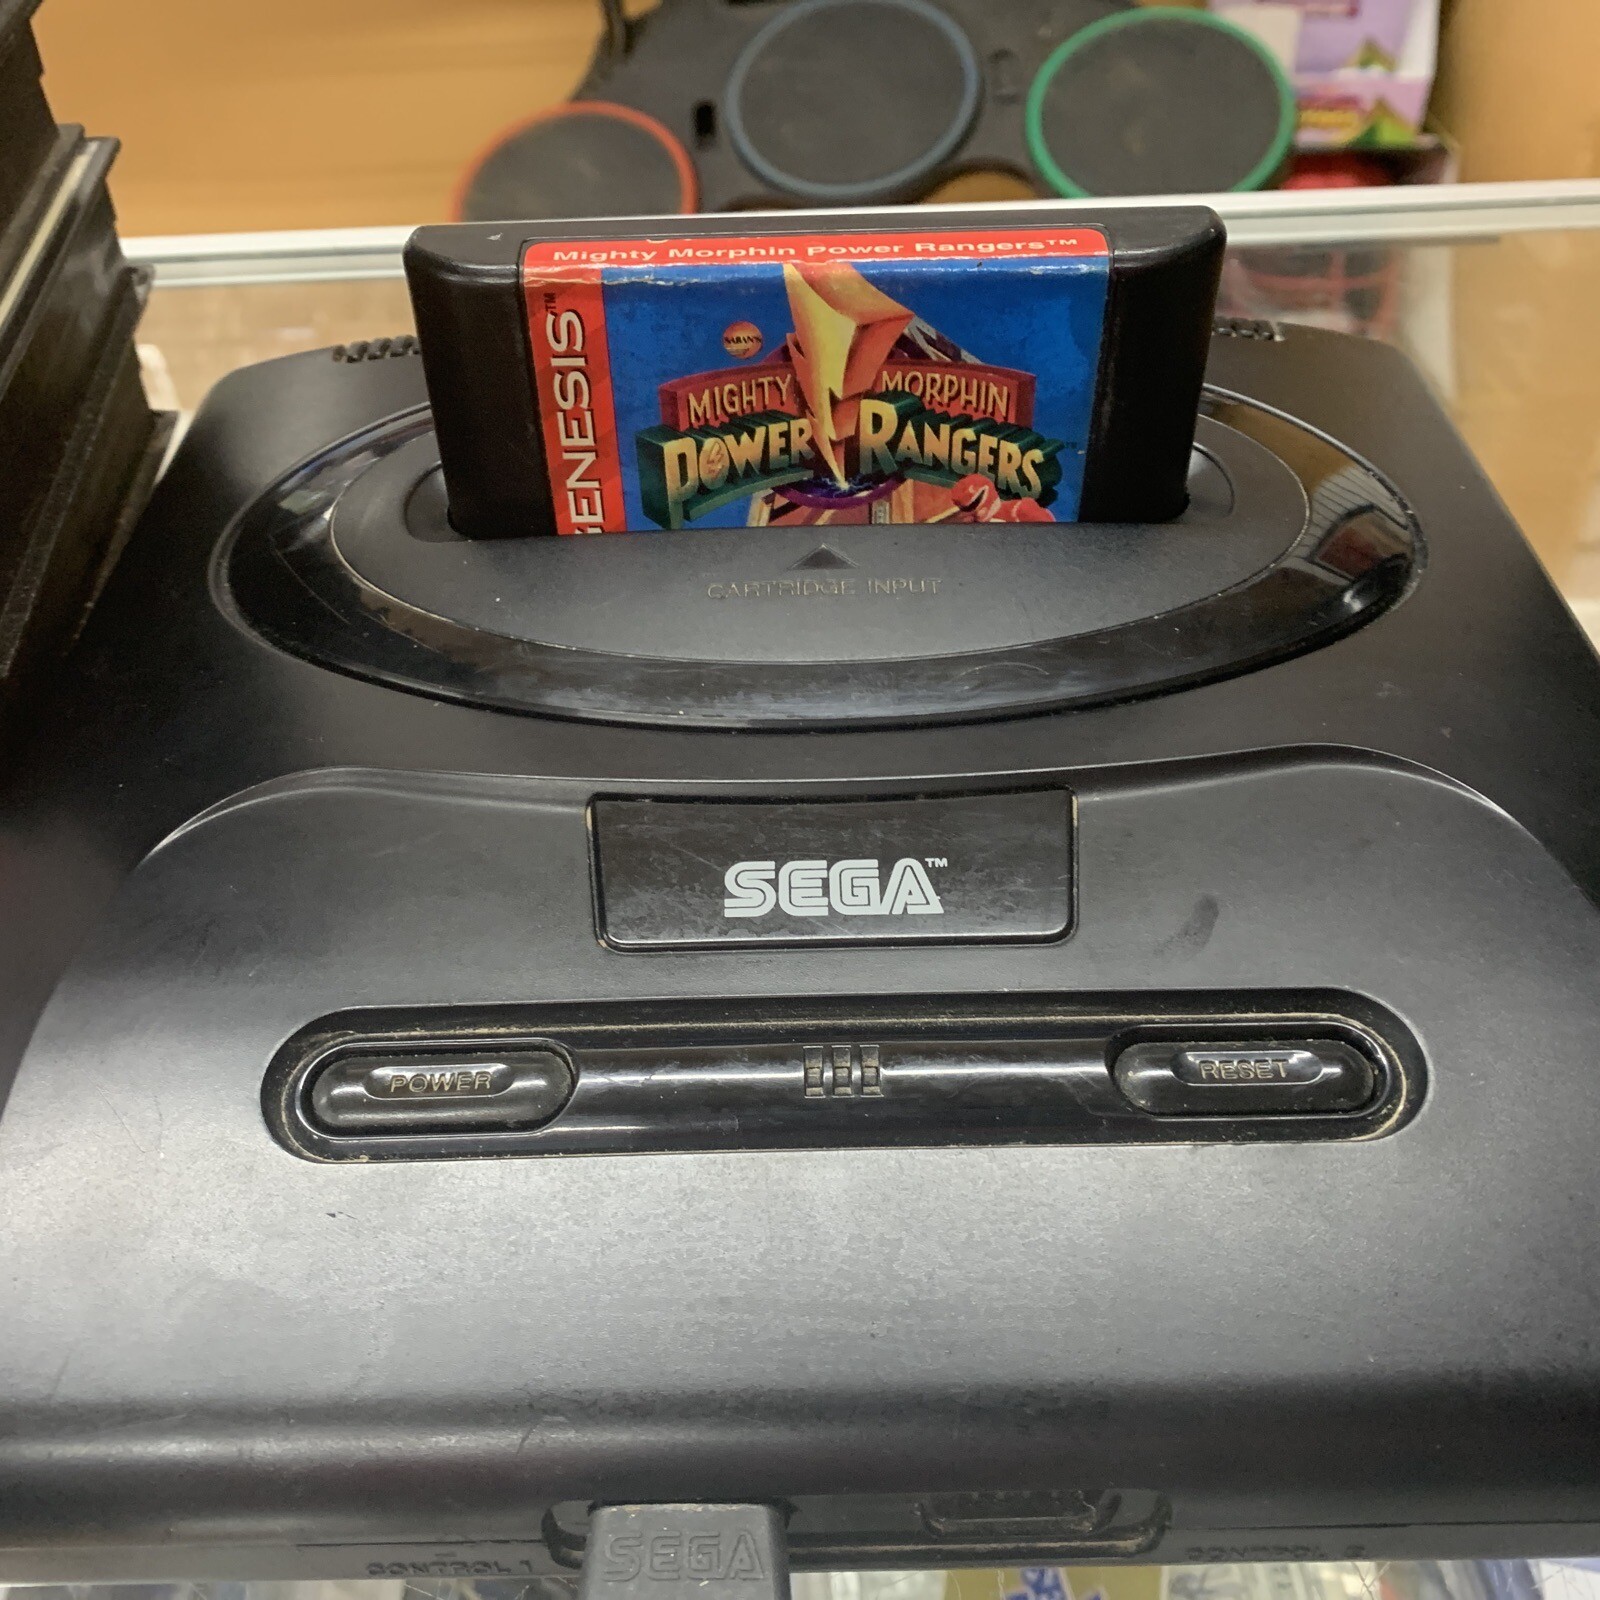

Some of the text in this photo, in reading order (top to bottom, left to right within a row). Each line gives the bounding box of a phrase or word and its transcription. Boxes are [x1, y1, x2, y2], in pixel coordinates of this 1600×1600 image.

[553, 249, 657, 262] Mighty
[668, 246, 795, 259] Morphin
[807, 243, 904, 256] Power
[688, 370, 1009, 424] MIGHTY MORPHIN
[663, 398, 1045, 530] POWER RANGERS
[706, 578, 942, 599] CARTRIDGE INPUT
[1200, 1058, 1290, 1080] RESET
[390, 1071, 493, 1093] POWER
[601, 1529, 766, 1583] SEGA
[366, 1559, 533, 1576] CONTROL 1
